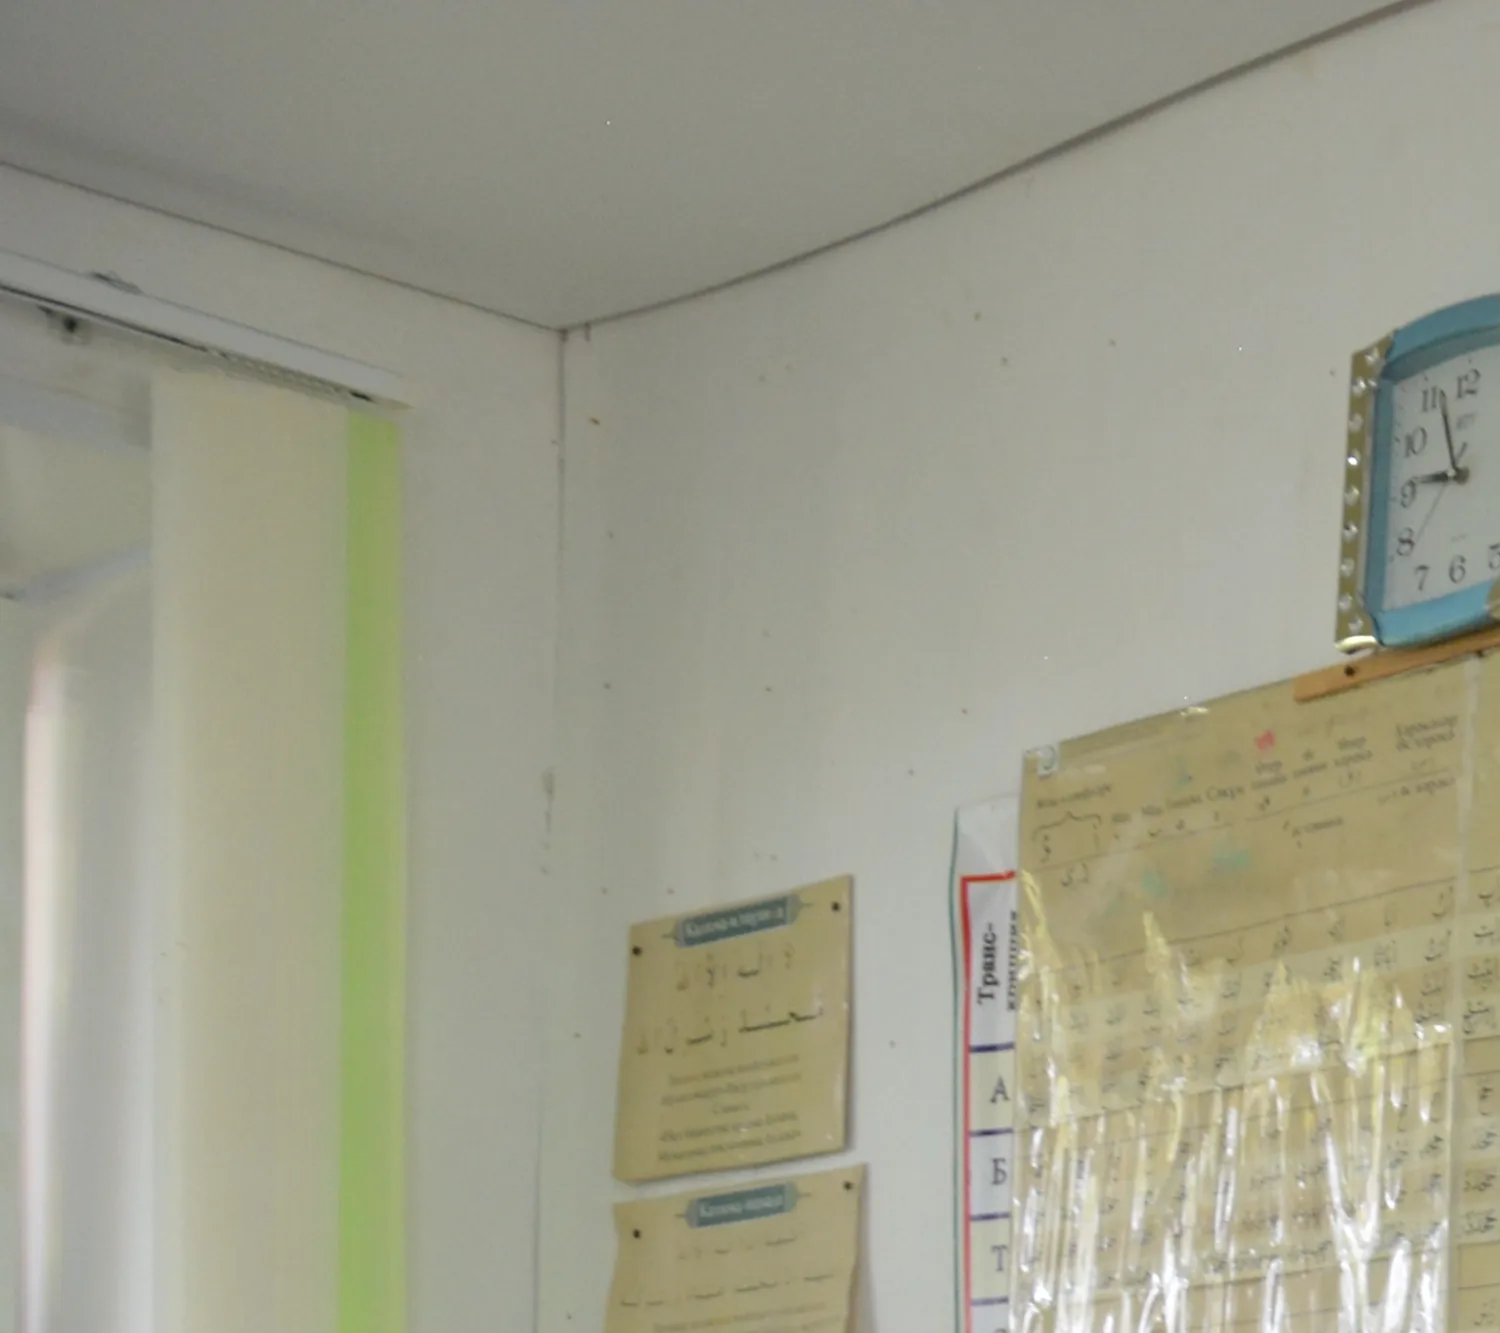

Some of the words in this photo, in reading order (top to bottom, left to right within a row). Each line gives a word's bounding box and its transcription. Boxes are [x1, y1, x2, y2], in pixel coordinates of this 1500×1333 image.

[1456, 369, 1480, 399] 12
[1422, 386, 1437, 412] 11
[1404, 426, 1427, 458] 10
[1401, 480, 1416, 508] 9
[1397, 528, 1415, 557] 8
[1415, 565, 1429, 591] 7
[1449, 555, 1467, 584] 6
[989, 1077, 1010, 1104] А
[992, 1158, 1007, 1185] Б
[991, 1245, 1009, 1272] Т
